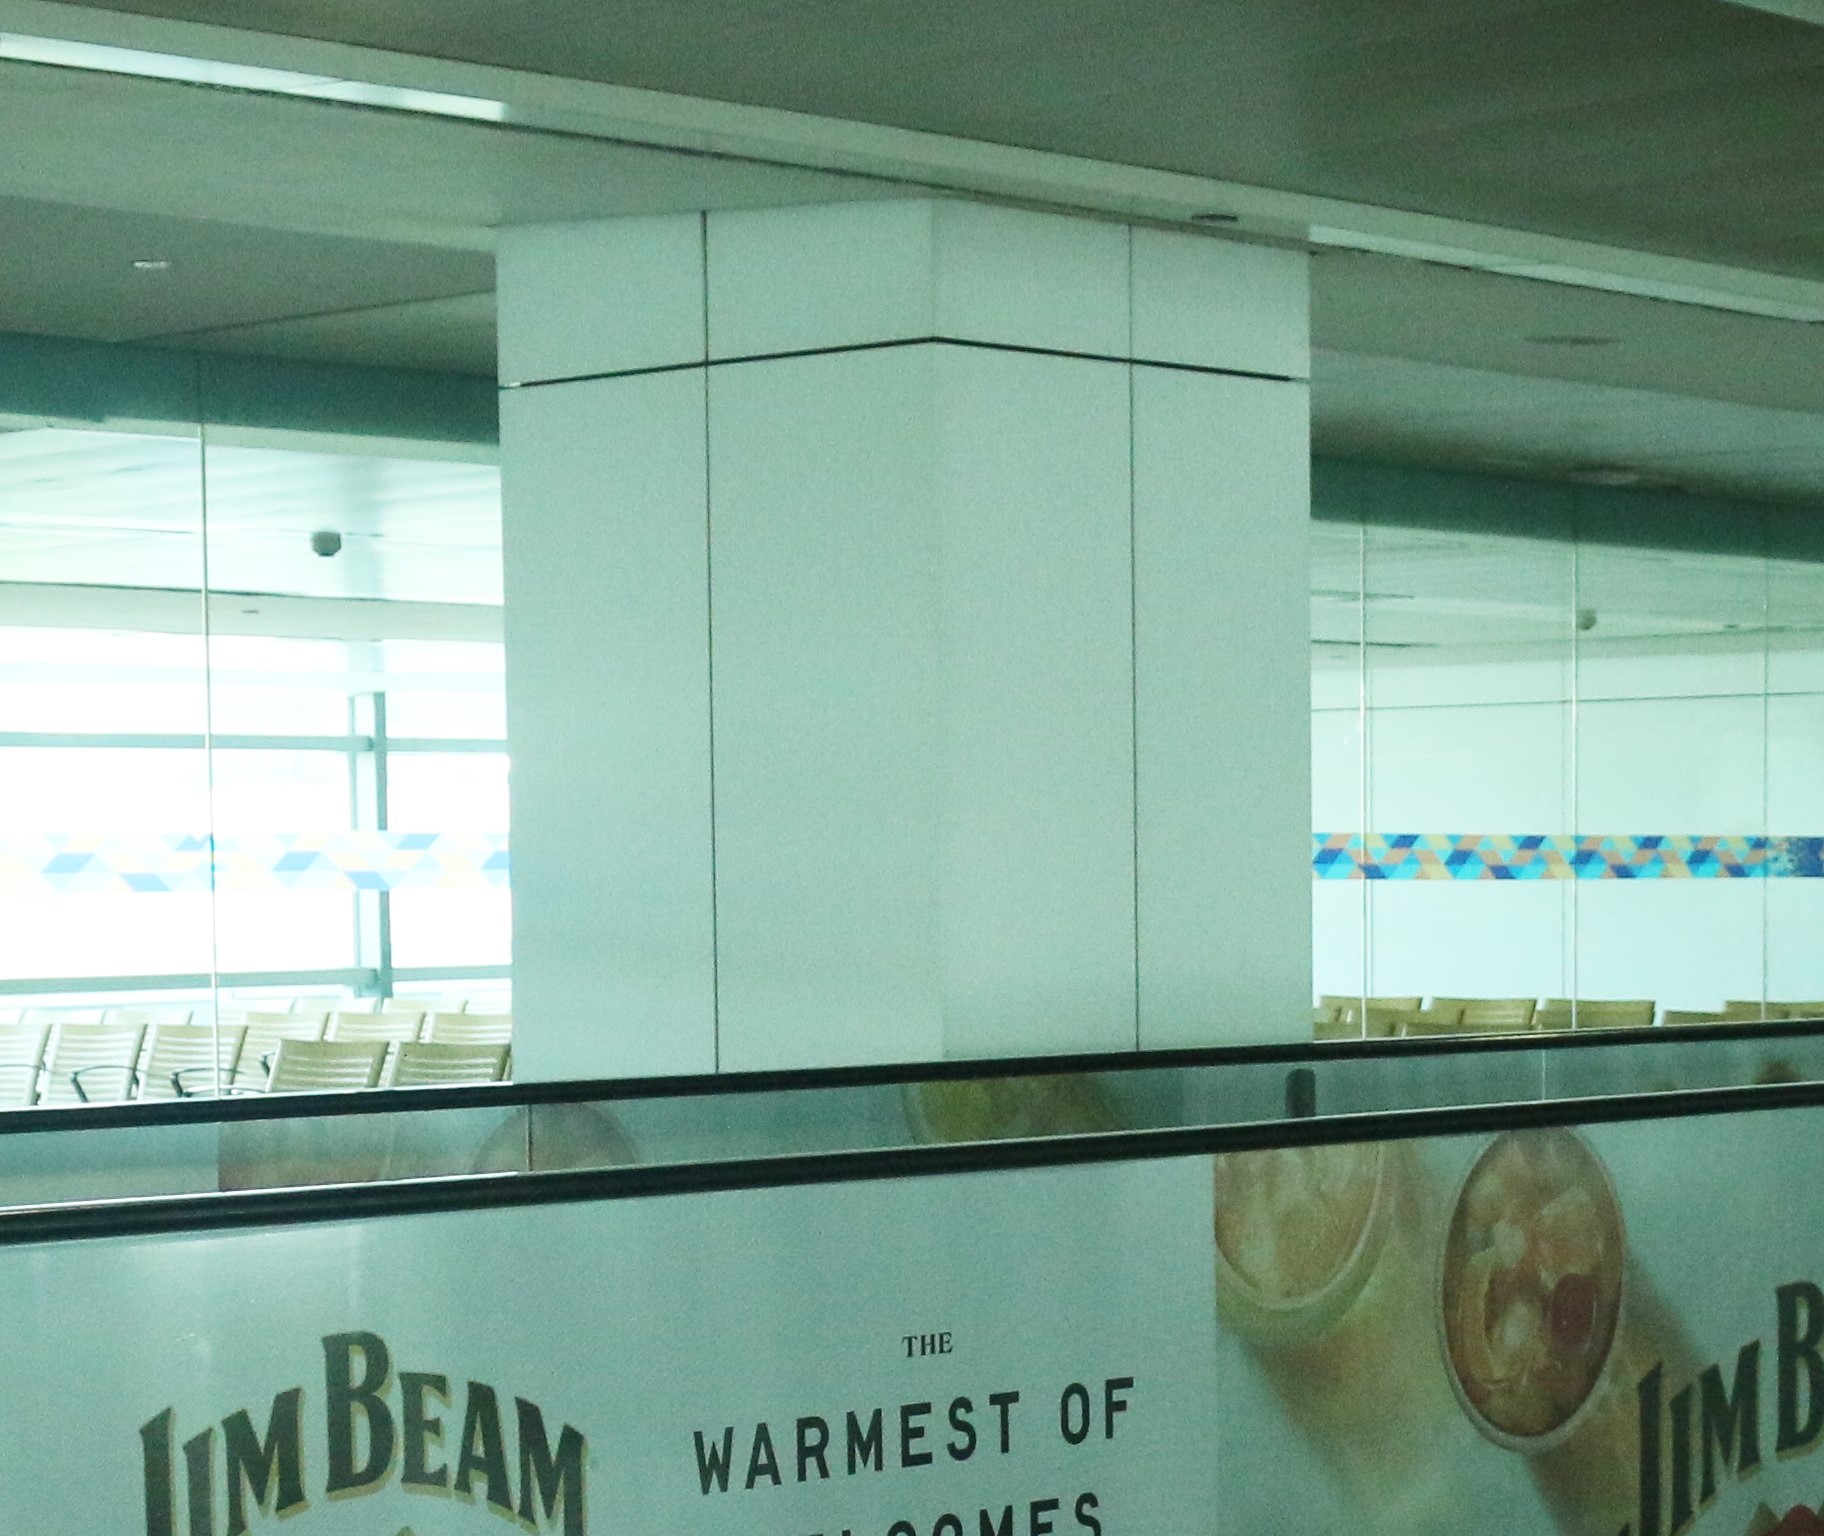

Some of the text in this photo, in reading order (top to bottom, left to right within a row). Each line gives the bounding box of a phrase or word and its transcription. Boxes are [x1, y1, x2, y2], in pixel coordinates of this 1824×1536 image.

[900, 1330, 954, 1358] THE
[692, 1376, 1136, 1497] WARMEST OF
